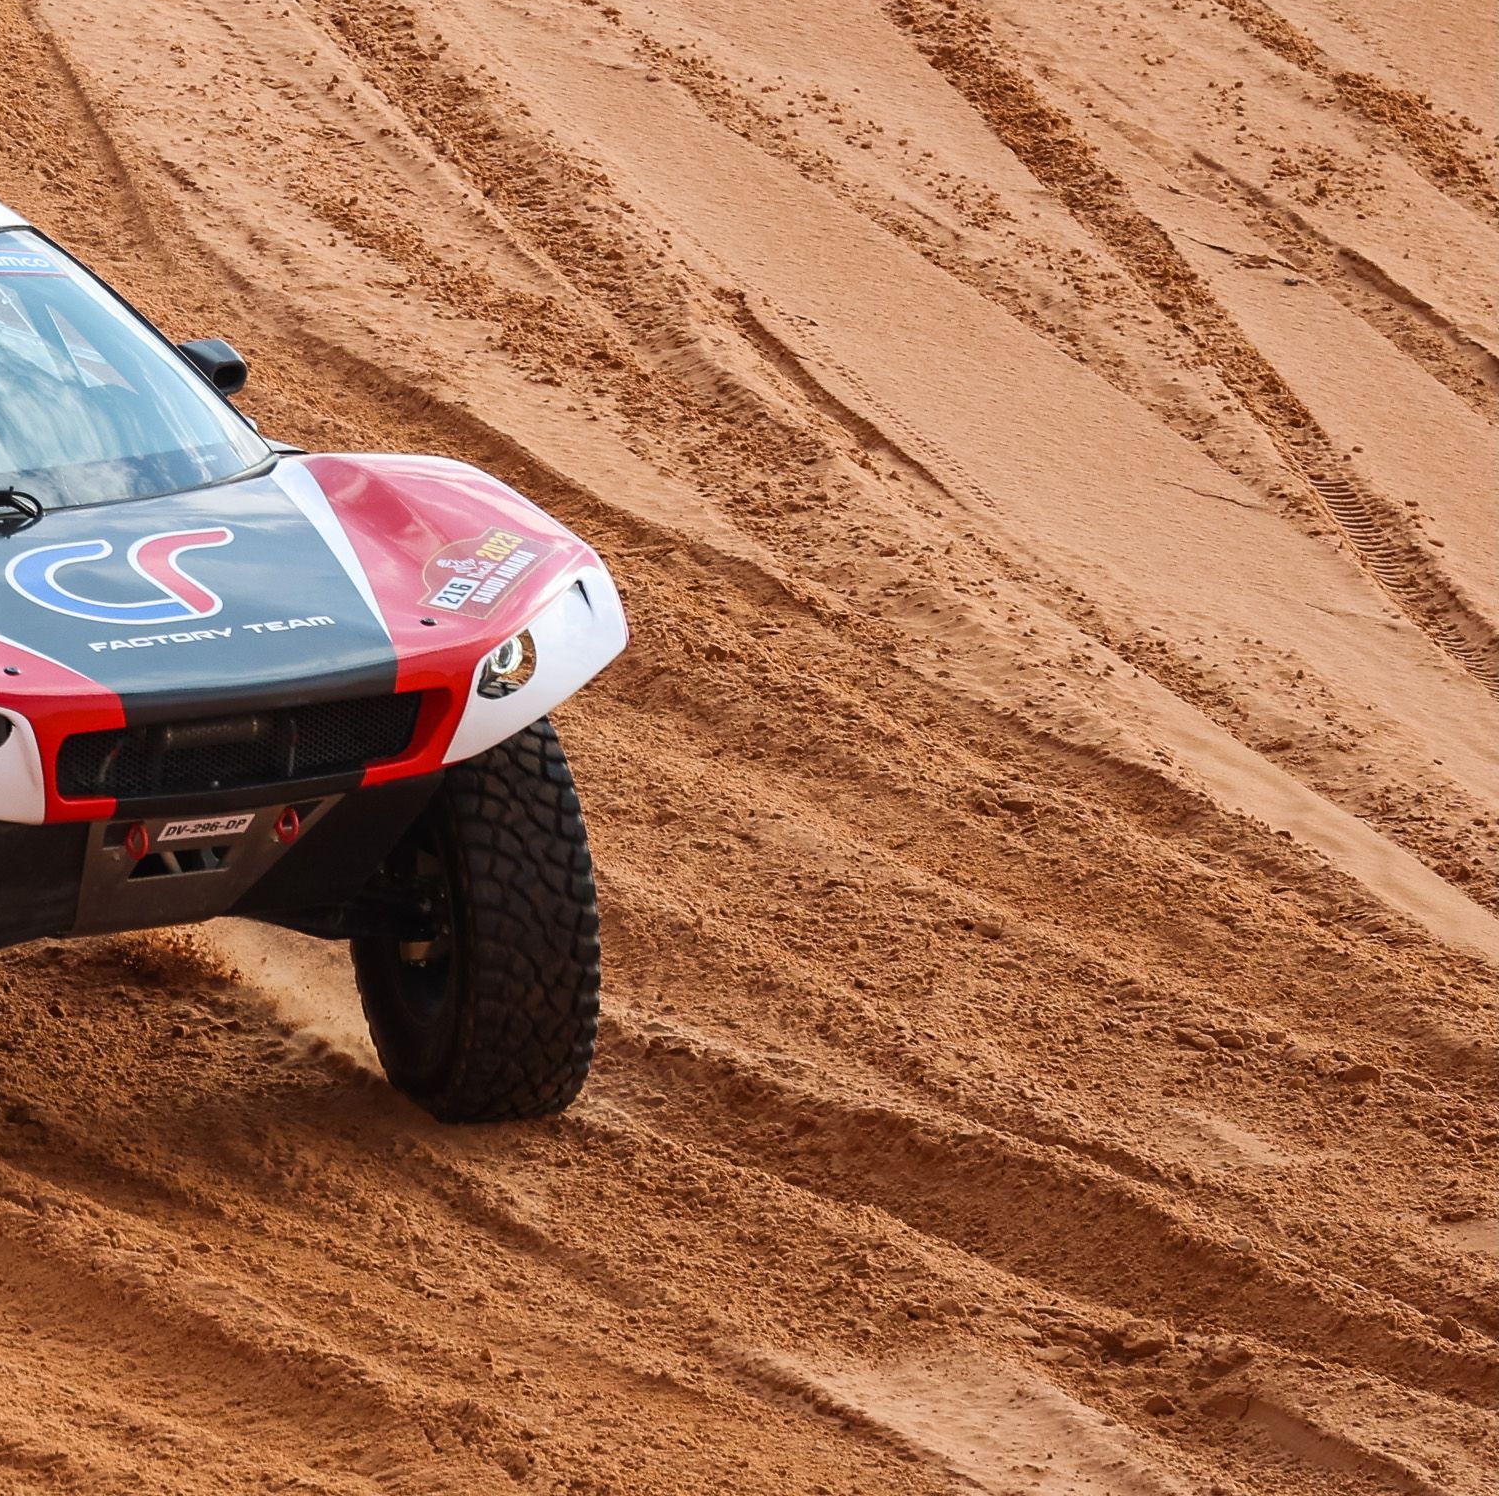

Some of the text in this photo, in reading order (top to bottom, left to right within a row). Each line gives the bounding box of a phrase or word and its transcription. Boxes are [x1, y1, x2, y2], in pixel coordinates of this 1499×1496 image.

[475, 531, 524, 562] 2023
[470, 549, 539, 604] SAUDI ARABIA
[437, 582, 473, 604] 216
[88, 616, 335, 653] FACTORY TEAM
[165, 819, 247, 837] DV-296-DP
